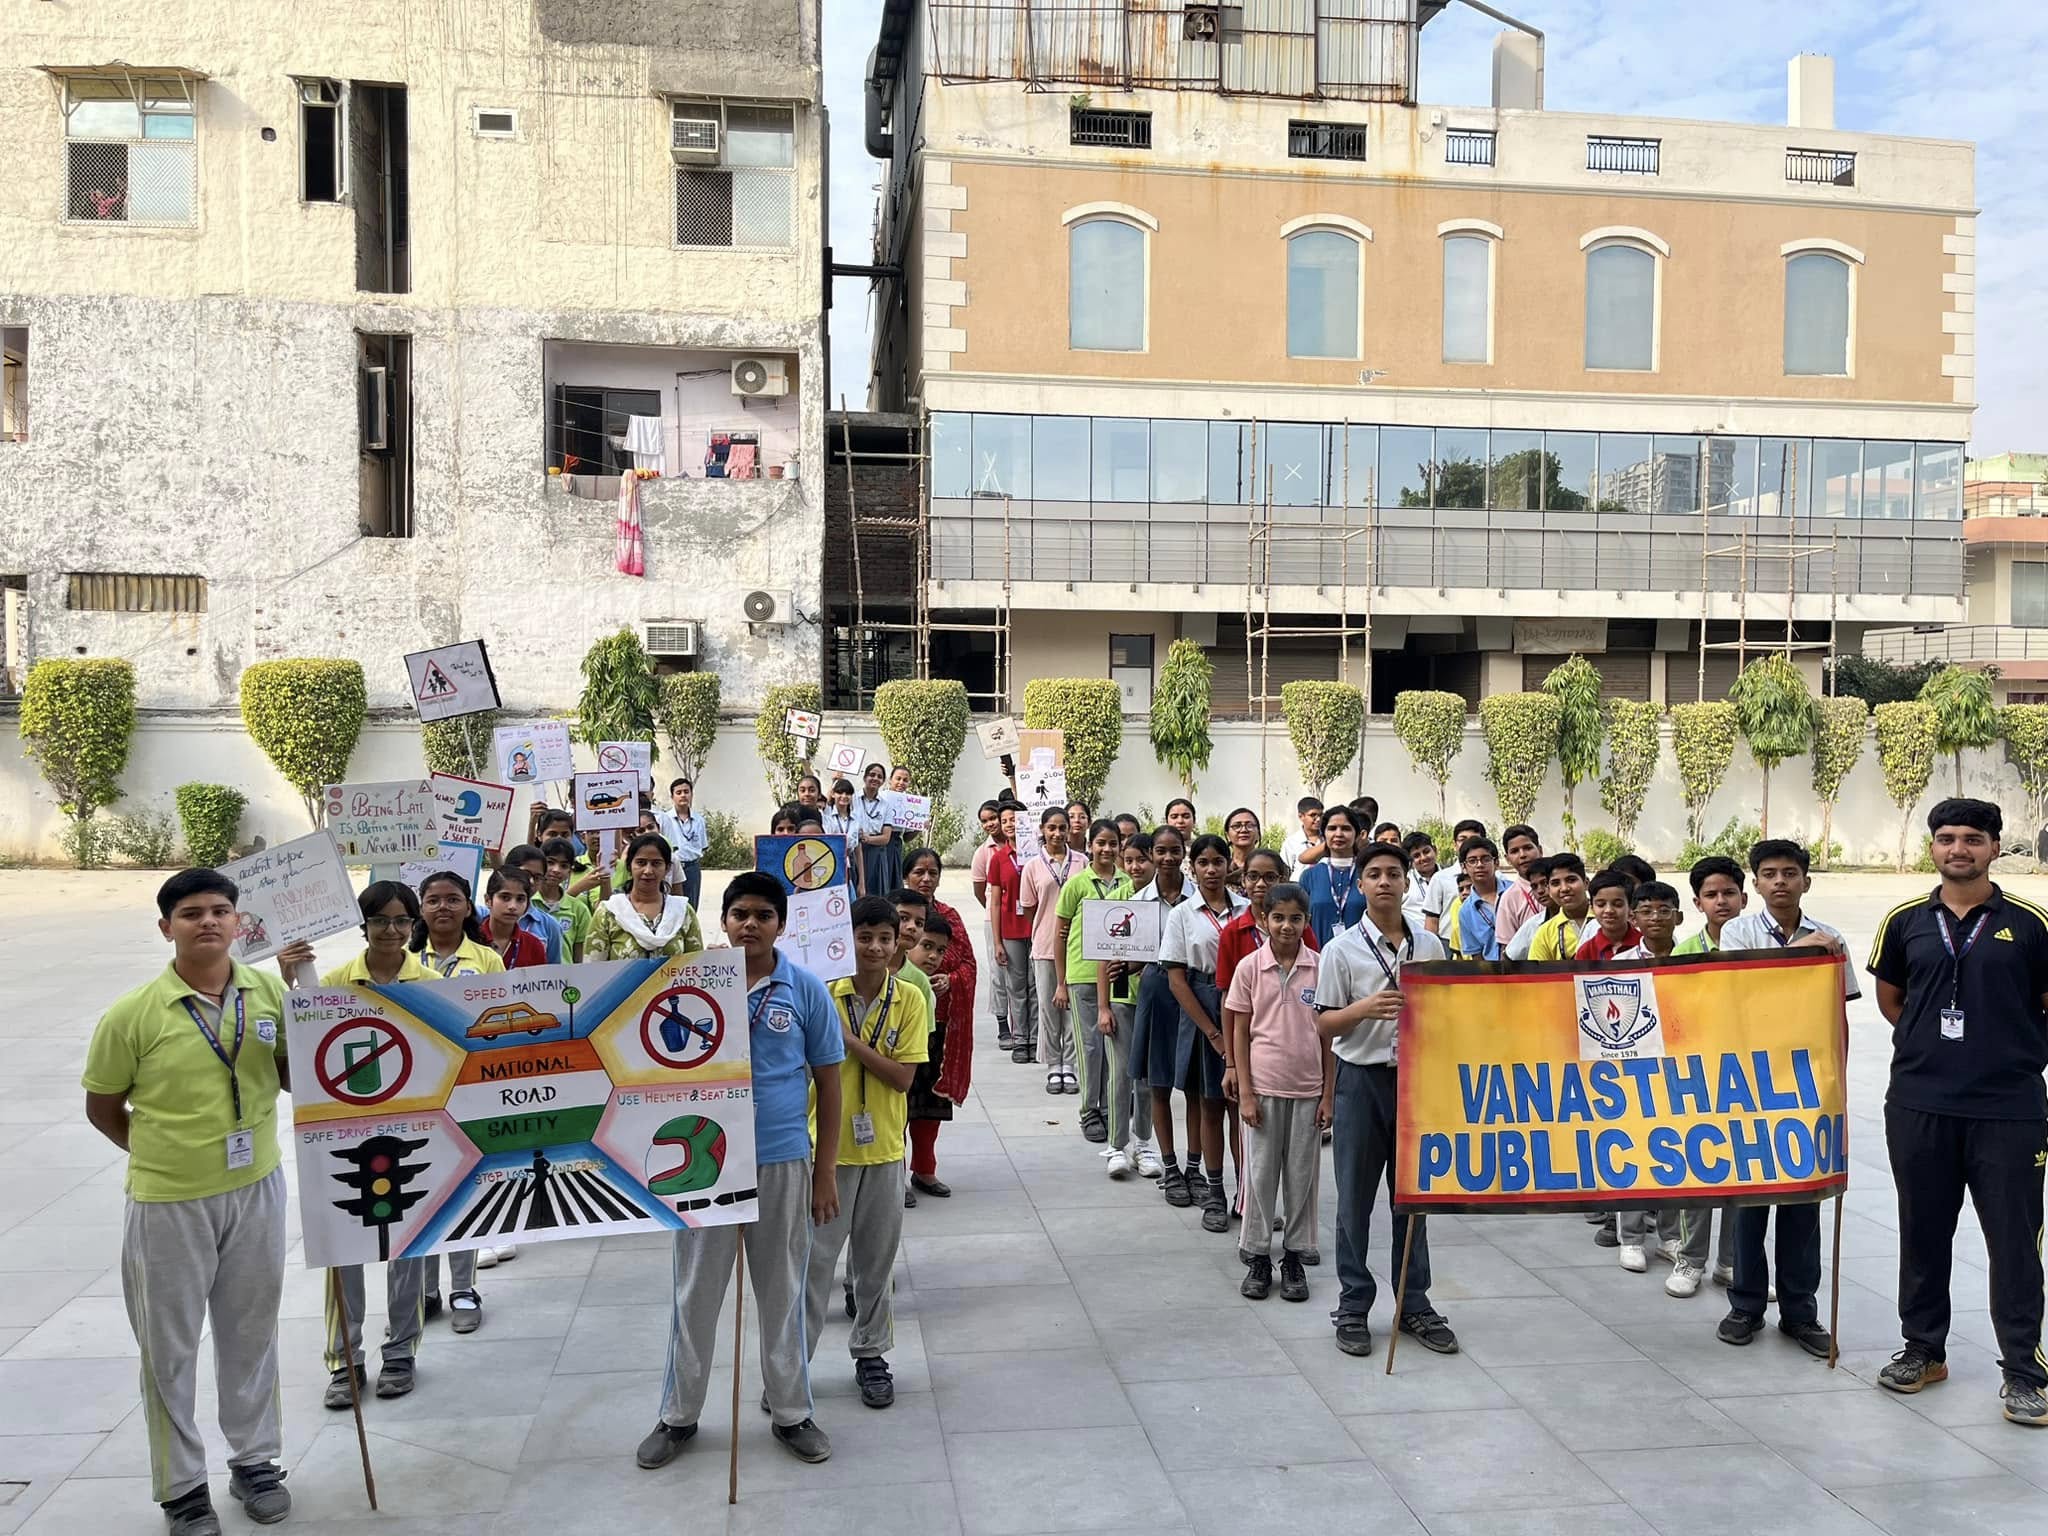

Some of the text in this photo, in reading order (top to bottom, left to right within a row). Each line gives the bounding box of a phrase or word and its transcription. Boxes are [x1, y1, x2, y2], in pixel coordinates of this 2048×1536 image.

[395, 789, 426, 816] LATE
[486, 801, 506, 810] WEAR
[338, 822, 353, 834] IS
[396, 822, 419, 831] THAN
[449, 823, 479, 834] HELMET
[442, 831, 492, 846] & SEAT BELT
[1143, 945, 1156, 953] AND
[660, 965, 738, 978] NEVER DRINK
[463, 979, 569, 1001] SPEED MAINTAIN
[671, 977, 733, 990] AND DRIVE
[1588, 984, 1637, 997] VANASTHALI
[292, 994, 357, 1009] NO MOBILE
[294, 1007, 384, 1022] WHILE DRIVING
[480, 1056, 576, 1080] NATIONAL
[1458, 1049, 1821, 1125] VANASTHALI
[499, 1086, 557, 1106] ROAD
[617, 1087, 749, 1105] USE HELMET & SEAT BELT
[303, 1131, 334, 1143] SAFE
[336, 1126, 372, 1139] DRIVE
[377, 1123, 408, 1135] SAFE
[1648, 1113, 1845, 1187] SCHOOL
[475, 1171, 503, 1185] STOP
